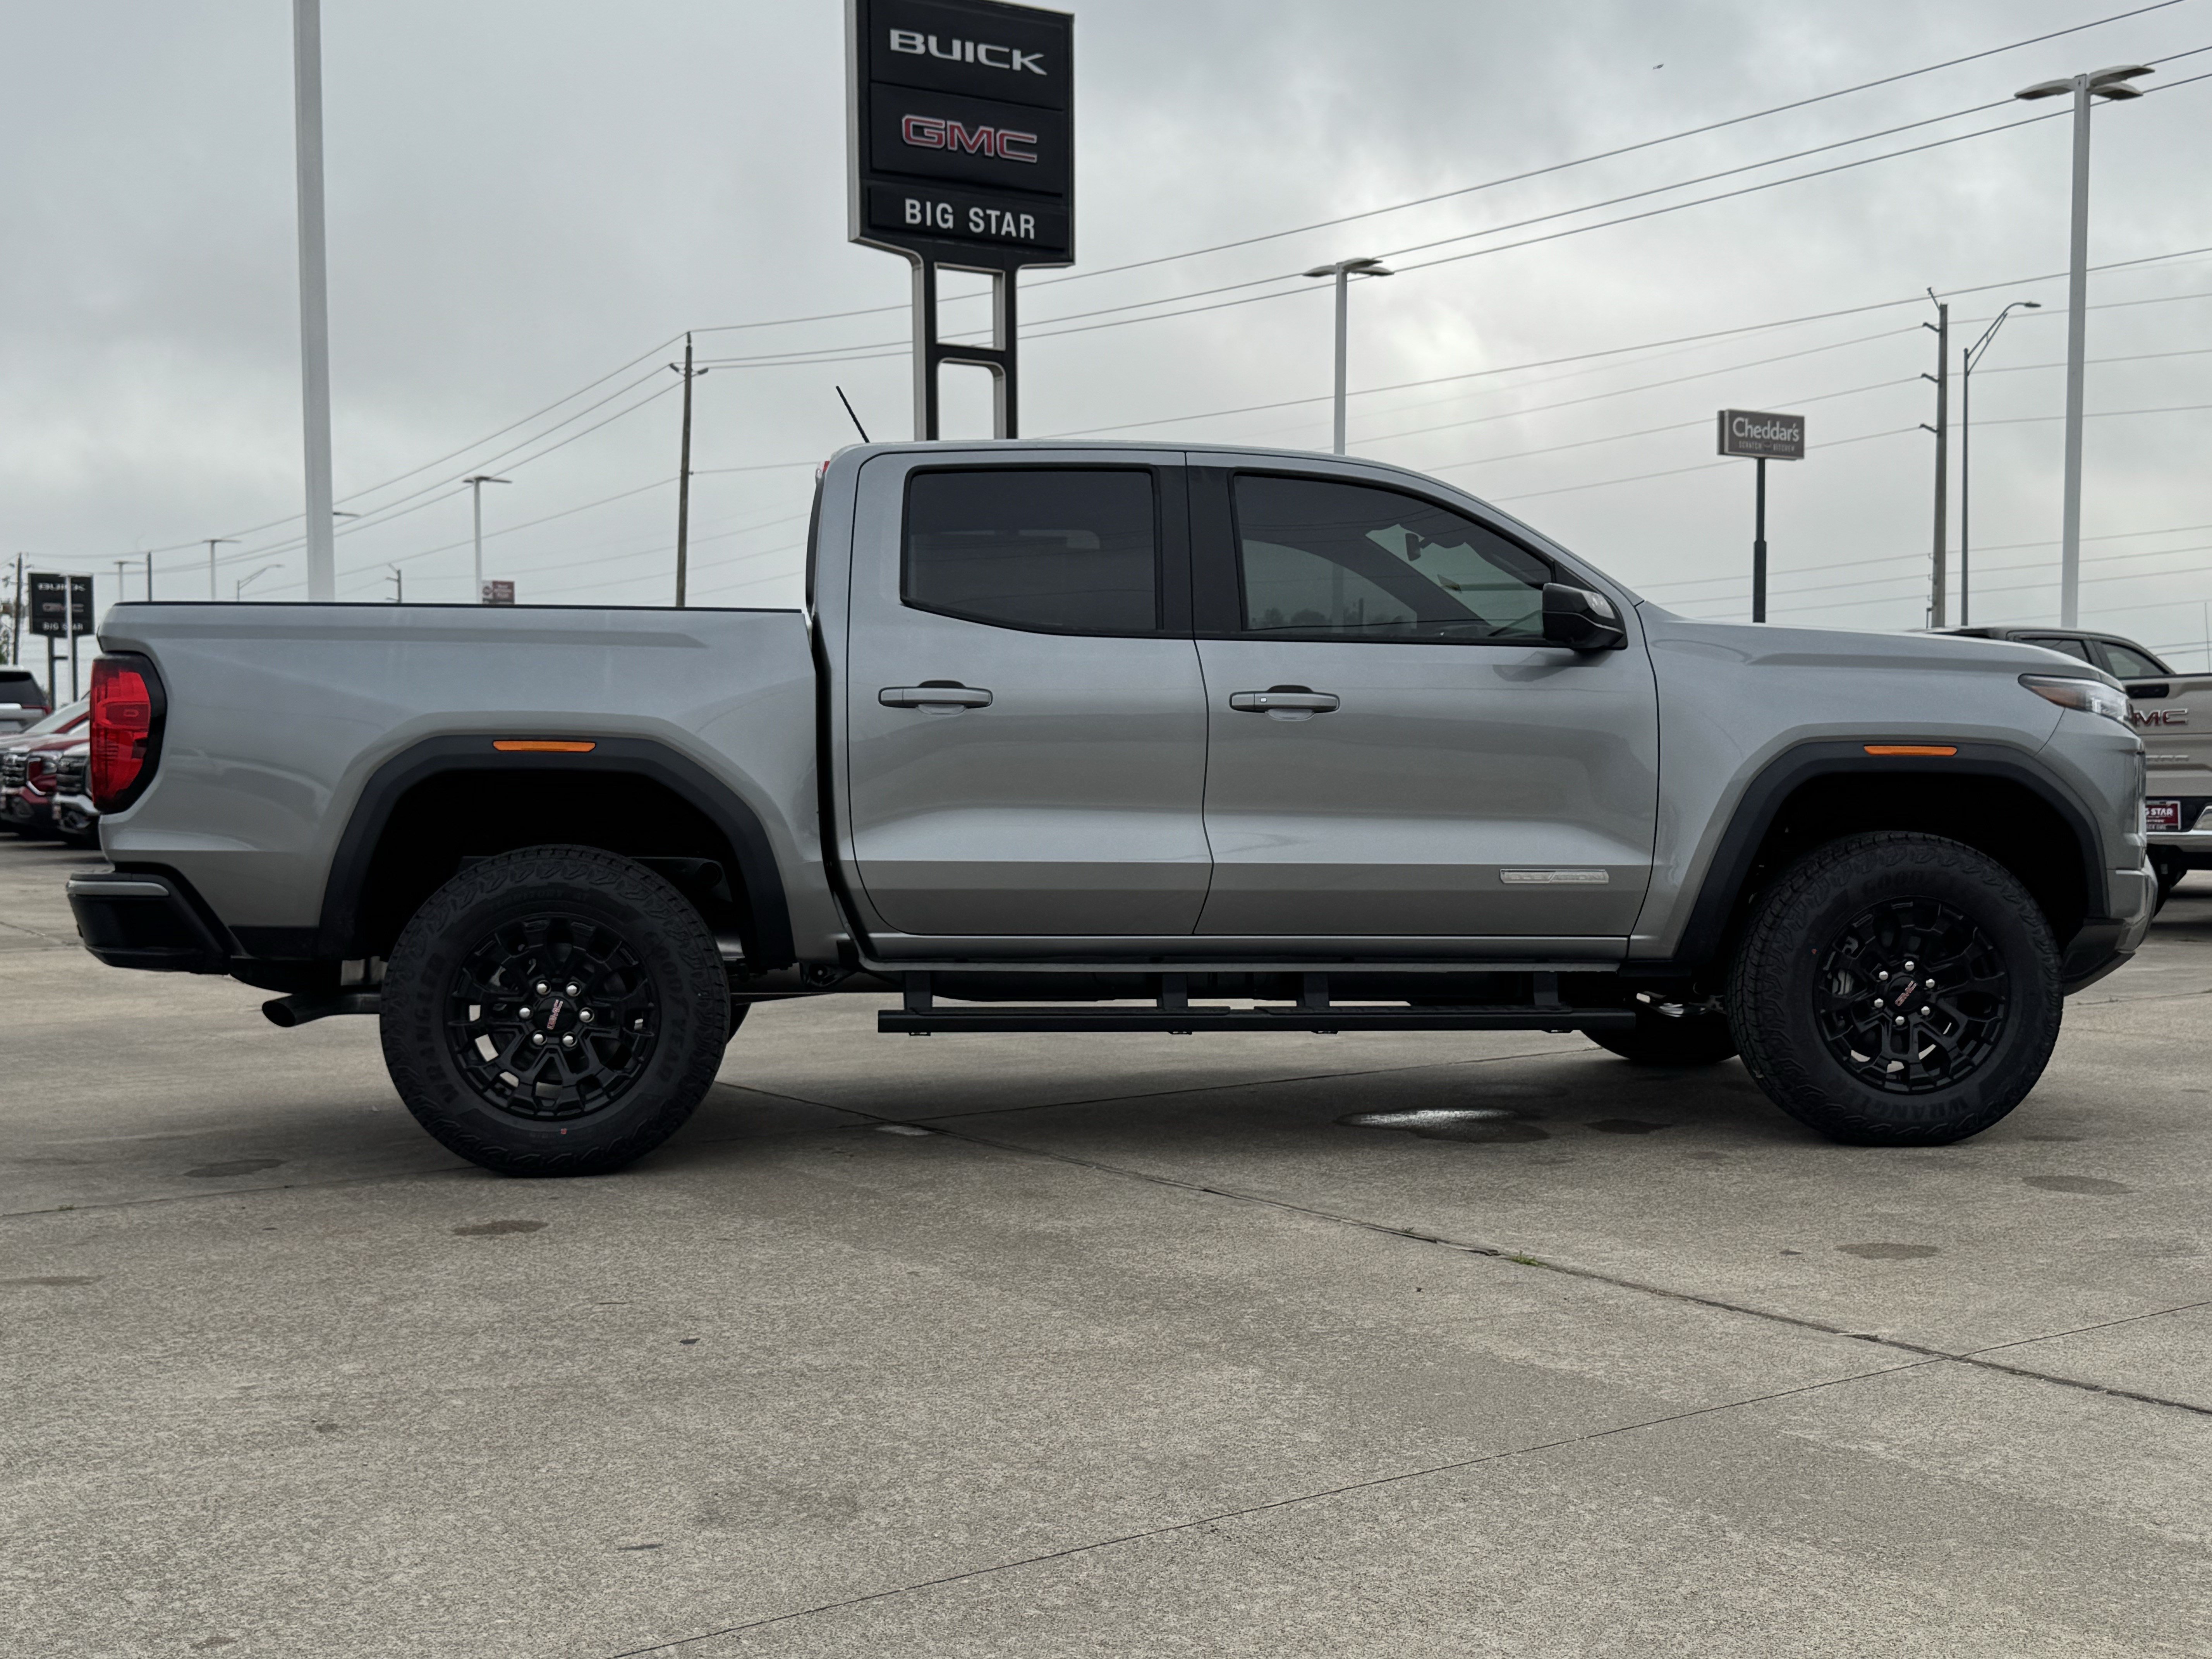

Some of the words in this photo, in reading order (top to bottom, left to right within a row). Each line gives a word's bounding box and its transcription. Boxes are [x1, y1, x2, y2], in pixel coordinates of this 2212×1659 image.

[890, 29, 1047, 75] BUICK
[902, 115, 1037, 163] GMC
[905, 198, 953, 229] BIG
[969, 207, 1035, 239] STAR
[1733, 417, 1800, 442] Cheddar's
[62, 622, 83, 631] SAR
[2133, 708, 2188, 726] MC
[2151, 807, 2173, 816] STAR
